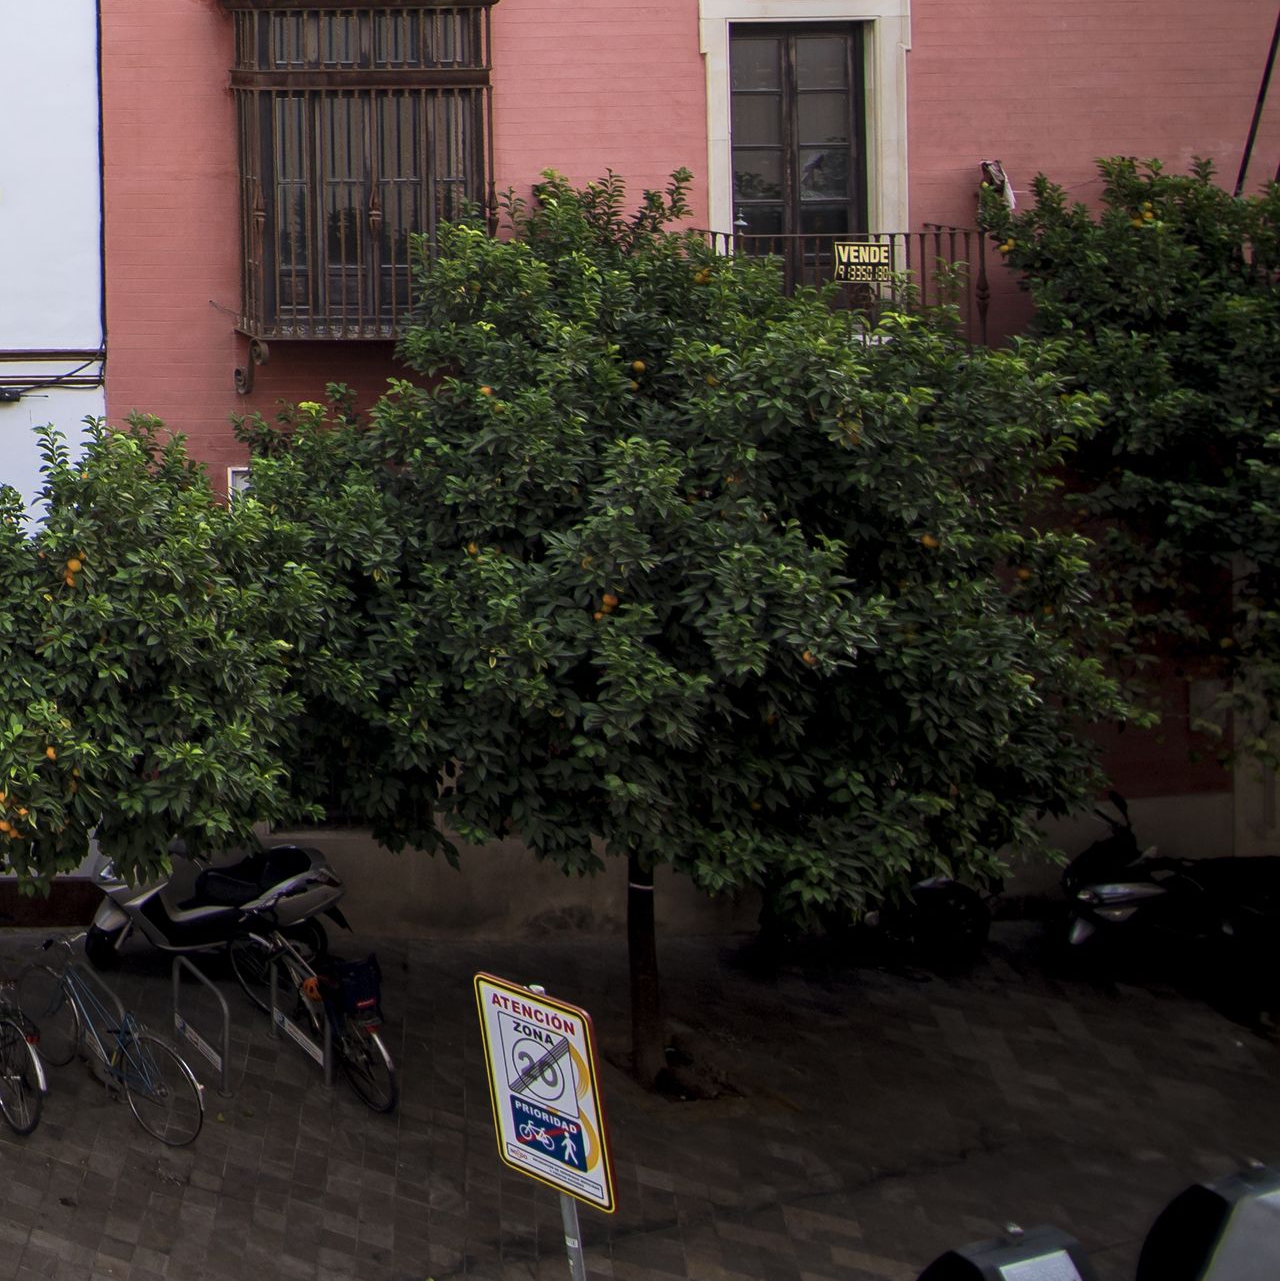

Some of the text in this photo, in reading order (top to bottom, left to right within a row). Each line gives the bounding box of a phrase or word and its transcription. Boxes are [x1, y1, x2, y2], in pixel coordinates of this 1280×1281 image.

[837, 245, 889, 263] VENDE
[491, 993, 575, 1036] ATENCIÓN
[512, 1020, 555, 1046] ZONA
[514, 1100, 577, 1134] PRIORIDAD
